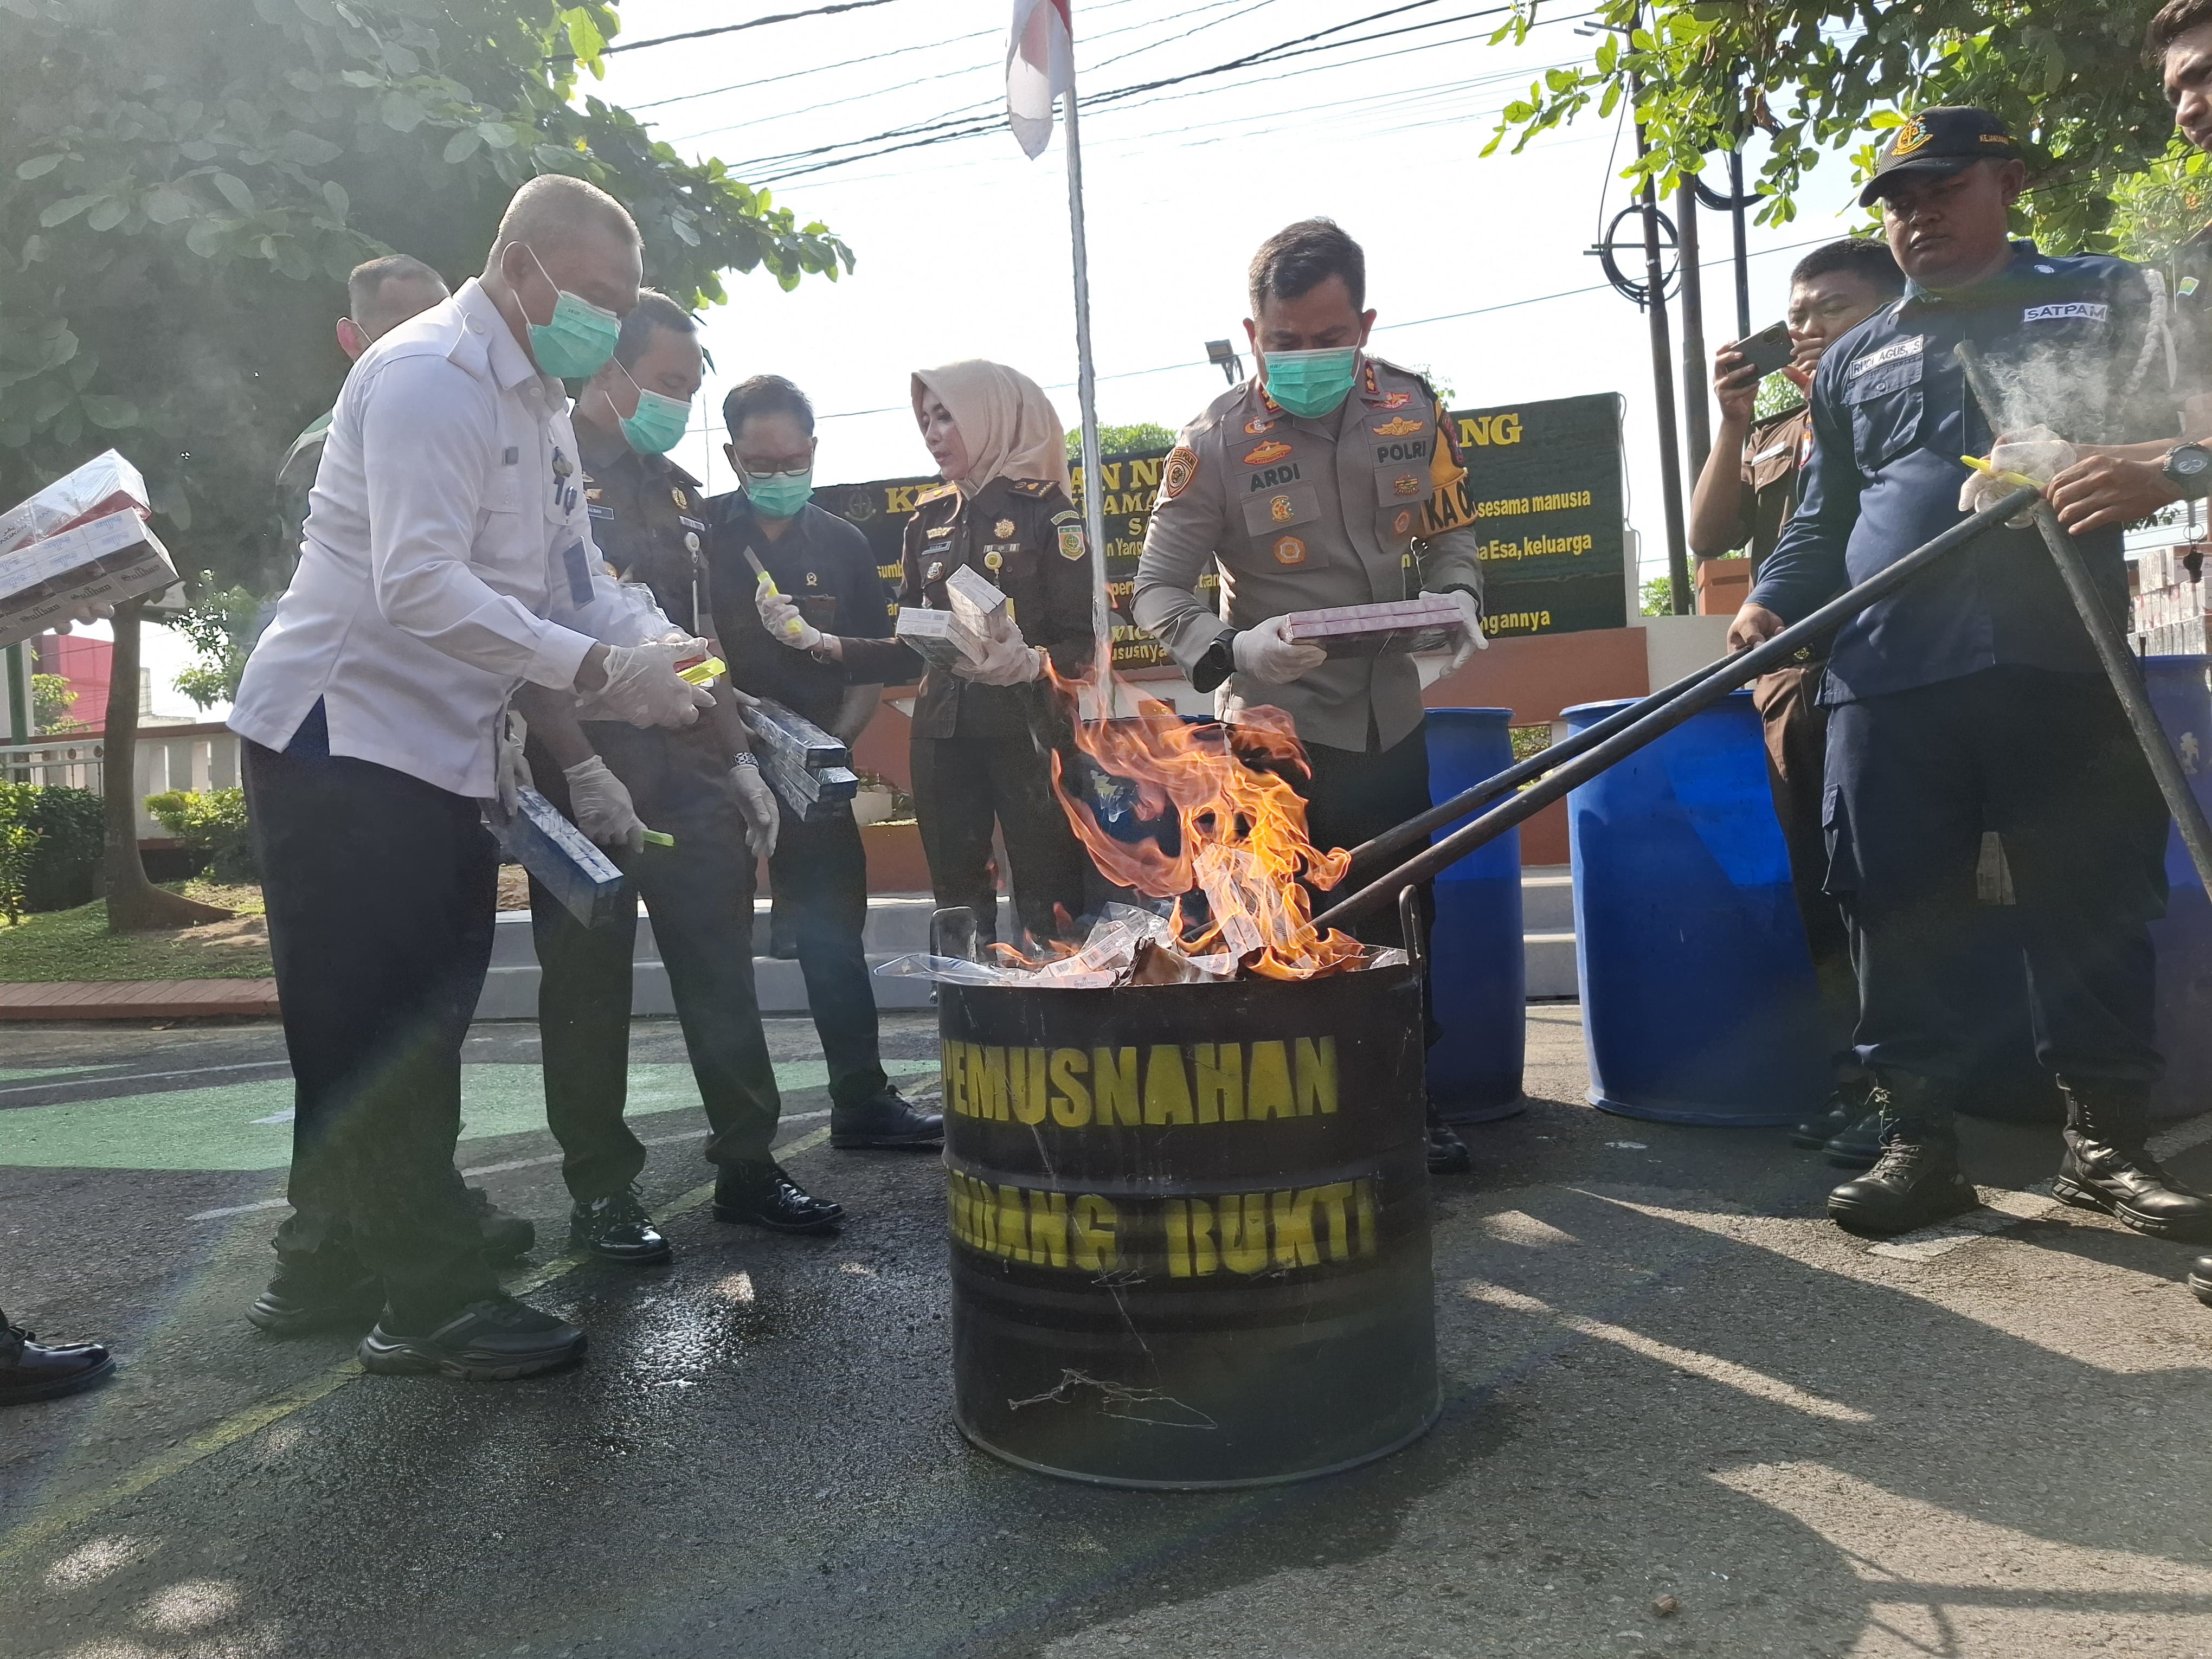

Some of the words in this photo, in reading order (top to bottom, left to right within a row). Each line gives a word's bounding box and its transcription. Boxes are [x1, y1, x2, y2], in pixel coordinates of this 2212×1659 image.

[2027, 304, 2105, 320] SATPAM
[1377, 441, 1426, 464] POLRI
[1250, 463, 1300, 492] ARDI
[1478, 497, 1529, 518] sesama
[1532, 490, 1591, 512] manusia
[1490, 539, 1522, 561] Esa,
[1523, 534, 1592, 556] keluarga
